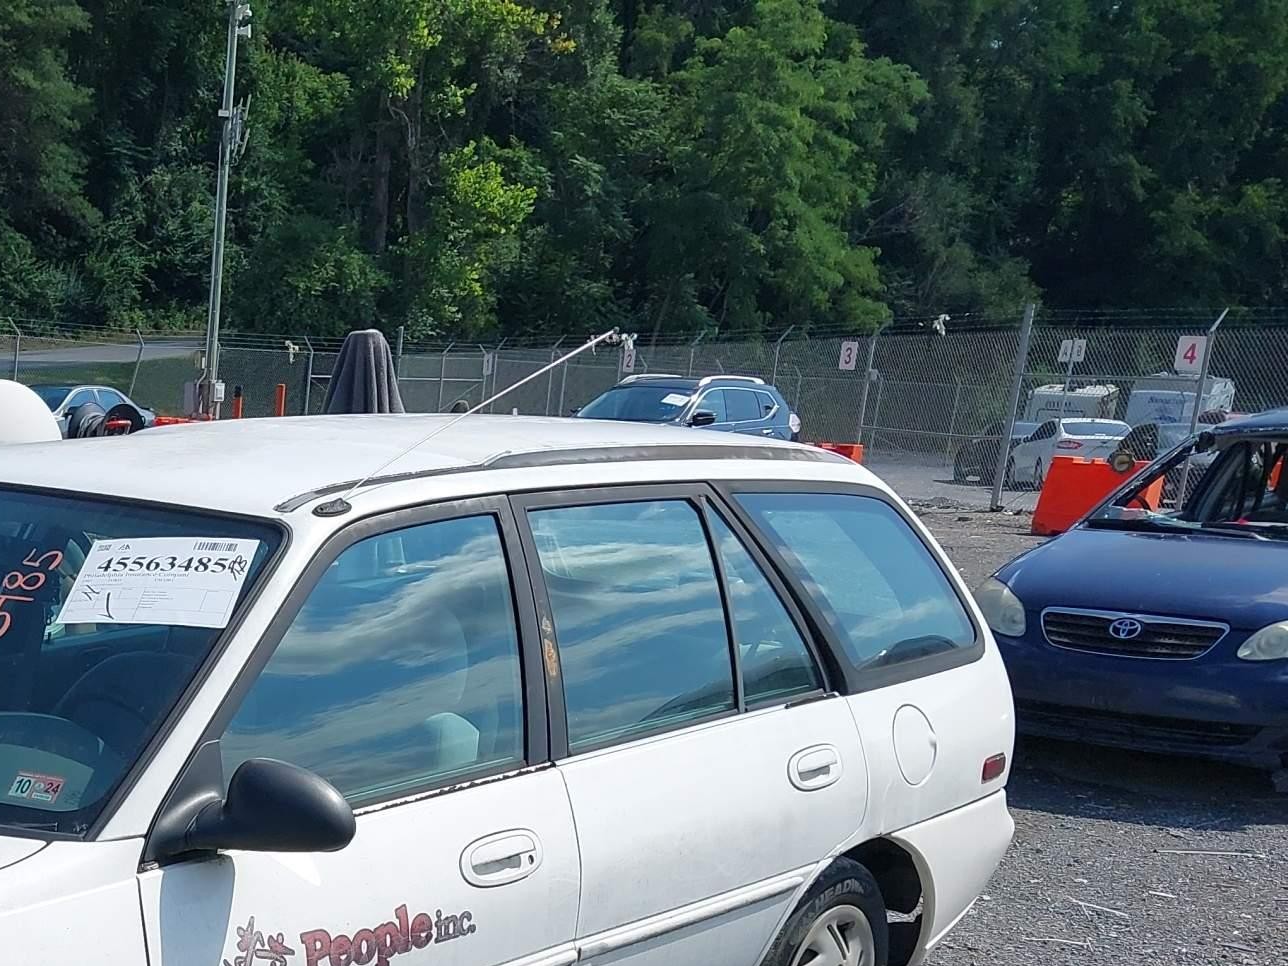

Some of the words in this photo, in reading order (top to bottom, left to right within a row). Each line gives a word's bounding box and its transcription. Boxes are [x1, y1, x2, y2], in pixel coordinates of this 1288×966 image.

[625, 353, 633, 368] 2
[844, 346, 853, 364] 3
[1182, 342, 1198, 365] 4
[97, 556, 229, 573] 45563485
[15, 778, 32, 794] 10
[43, 782, 61, 795] 24
[434, 909, 477, 944] inc.
